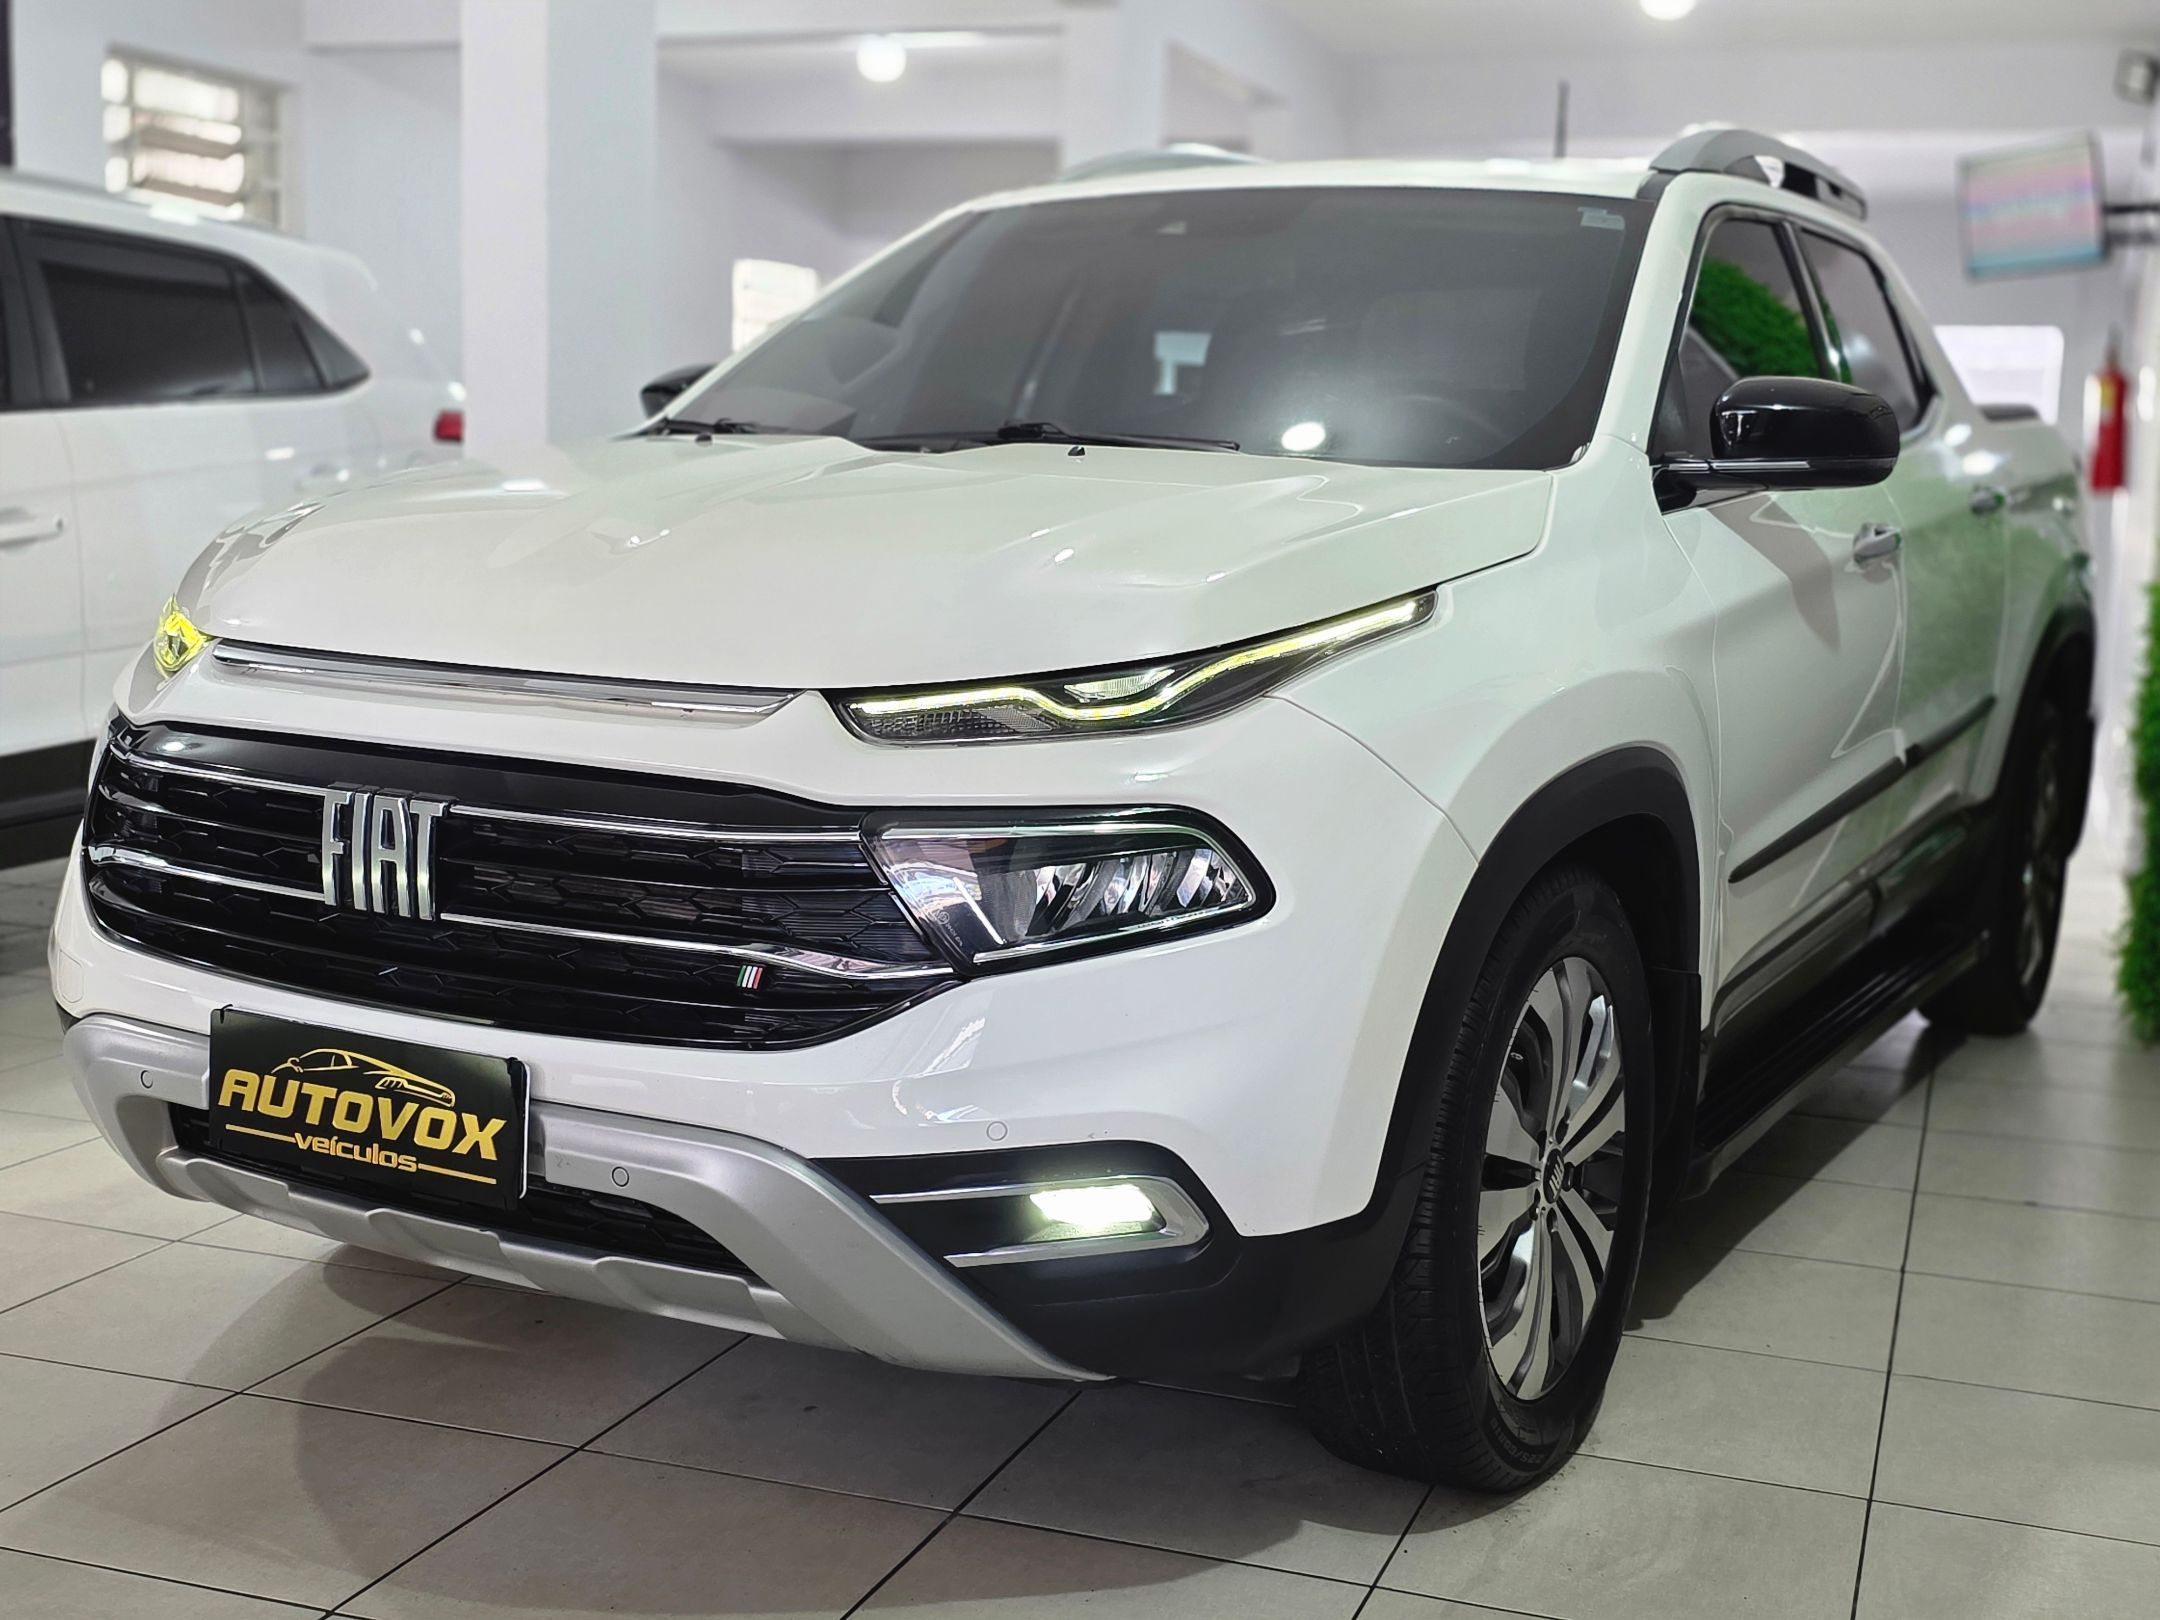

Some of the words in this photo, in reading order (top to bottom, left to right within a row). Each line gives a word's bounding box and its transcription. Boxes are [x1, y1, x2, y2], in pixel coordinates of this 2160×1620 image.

[321, 787, 448, 921] FIAT
[217, 1068, 507, 1161] AUTOVOX
[294, 1132, 418, 1172] veículos
